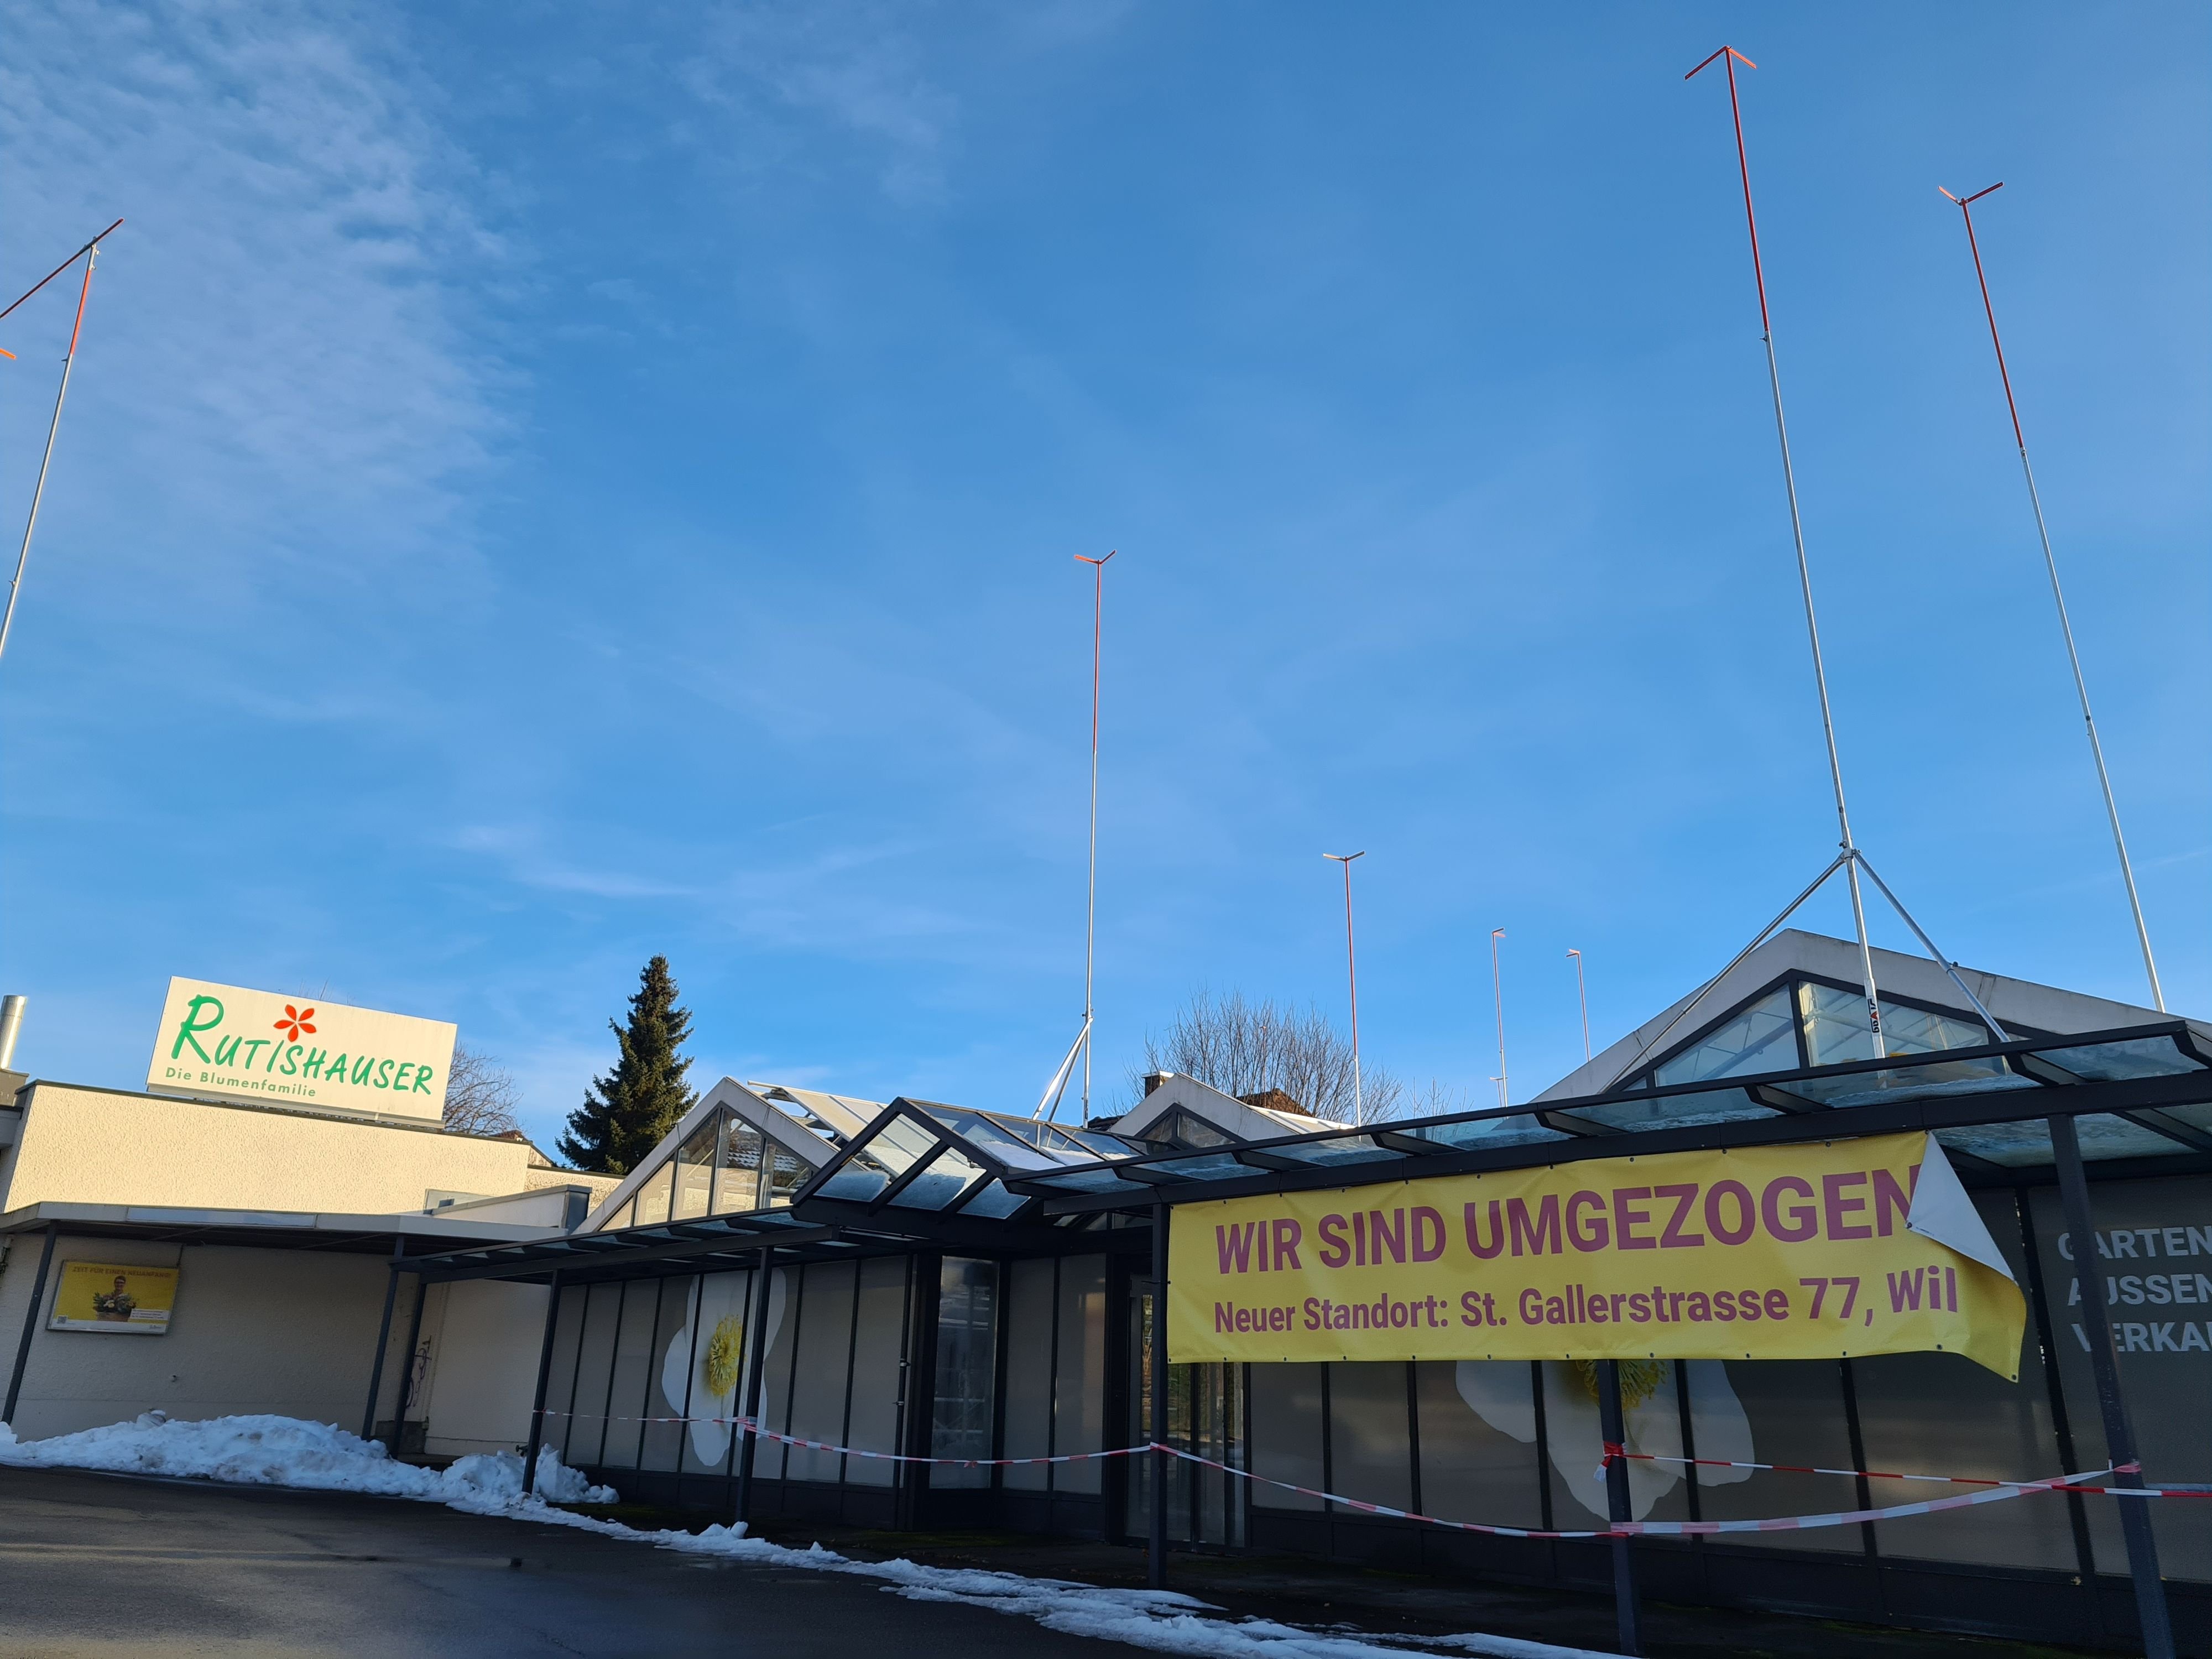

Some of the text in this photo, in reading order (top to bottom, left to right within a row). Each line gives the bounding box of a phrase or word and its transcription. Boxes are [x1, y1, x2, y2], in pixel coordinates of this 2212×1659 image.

[165, 1067, 316, 1097] Die Blumenfamilie
[171, 994, 434, 1095] RUTISHAUSER
[1215, 1164, 1922, 1274] WIR SIND UMGEZOGEN
[1214, 1265, 1958, 1333] Neuer Standort: St. Gallerstrasse 77, Wil
